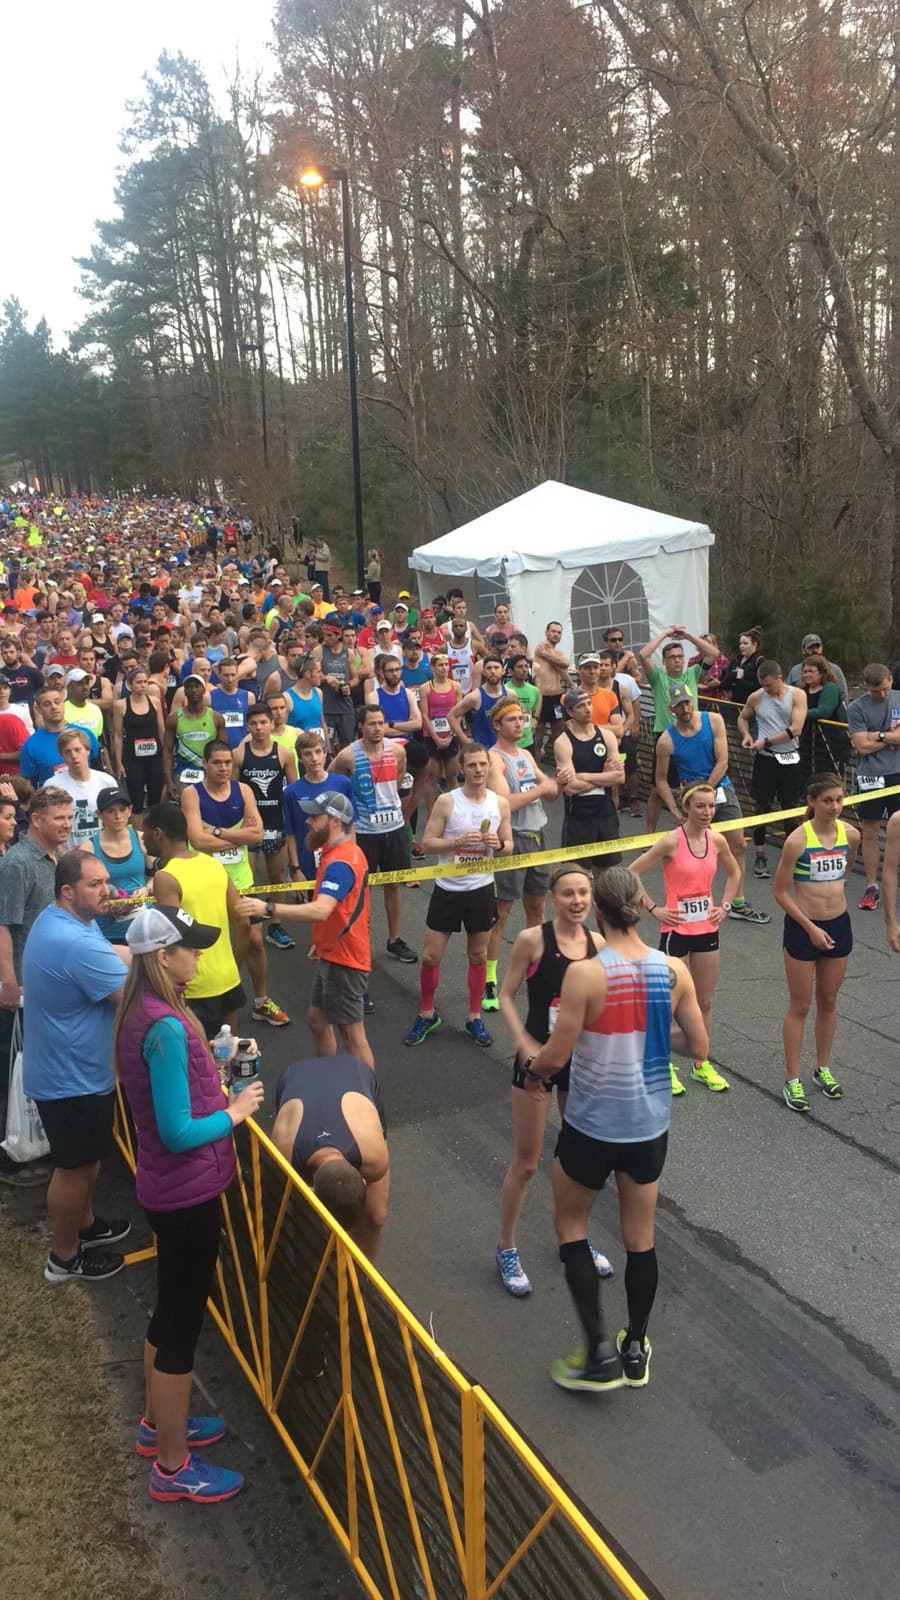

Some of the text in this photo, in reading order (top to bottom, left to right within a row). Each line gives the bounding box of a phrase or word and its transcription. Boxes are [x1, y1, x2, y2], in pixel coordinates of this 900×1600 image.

[374, 812, 394, 823] 1111
[815, 859, 843, 873] 1515
[683, 899, 710, 914] 1519
